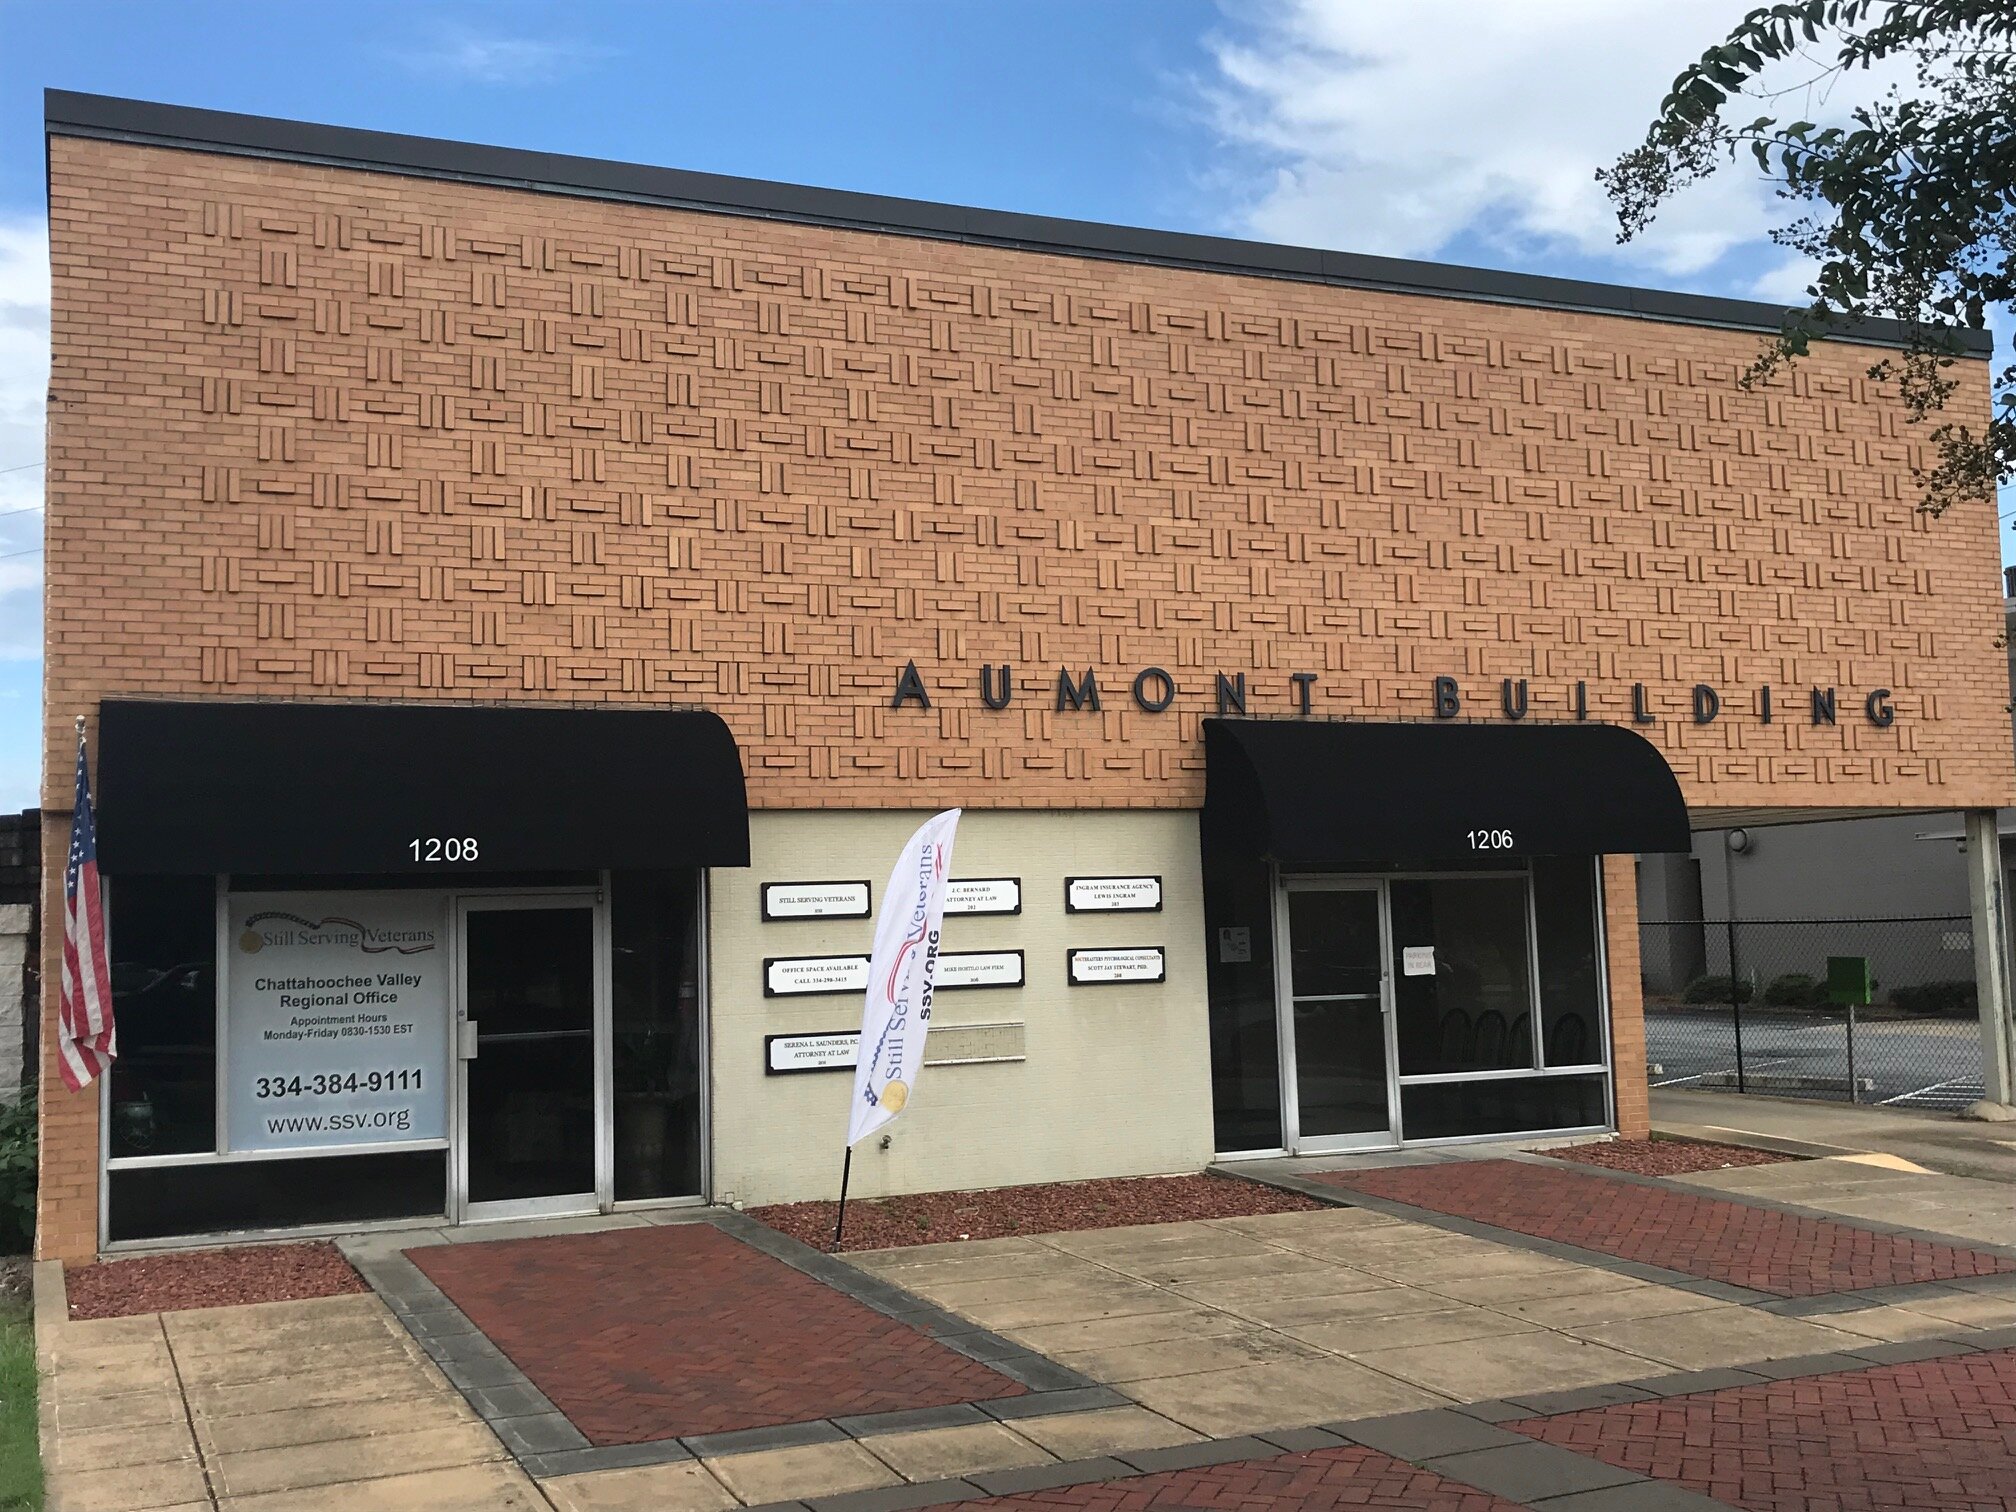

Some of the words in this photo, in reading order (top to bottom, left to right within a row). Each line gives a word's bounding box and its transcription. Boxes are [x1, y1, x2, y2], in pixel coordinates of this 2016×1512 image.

[892, 658, 1318, 716] AUMONT
[1433, 675, 1894, 727] BUILDING
[1467, 829, 1514, 850] 1206
[409, 838, 479, 862] 1208
[797, 896, 823, 904] SERVING
[824, 895, 856, 903] VETERANS
[263, 930, 293, 946] Still
[298, 931, 359, 948] Serving
[366, 928, 435, 943] Veterans
[885, 1038, 904, 1080] Still
[907, 843, 932, 940] Veterans
[255, 974, 372, 991] Chattahoochee
[377, 973, 422, 988] Valley
[920, 930, 940, 1021] SSV.ORG
[280, 992, 349, 1010] Regional
[353, 991, 398, 1005] Office
[290, 1014, 355, 1027] Appointment
[358, 1013, 388, 1024] Hours
[264, 1027, 339, 1041] Monday-Friday
[341, 1025, 391, 1037] 0830-1530
[393, 1024, 413, 1035] EST
[784, 1041, 808, 1049] SERENA
[794, 1051, 827, 1059] ATTORNEY
[256, 1068, 422, 1099] 334-384-9111
[267, 1108, 411, 1134] www.ssv.org
